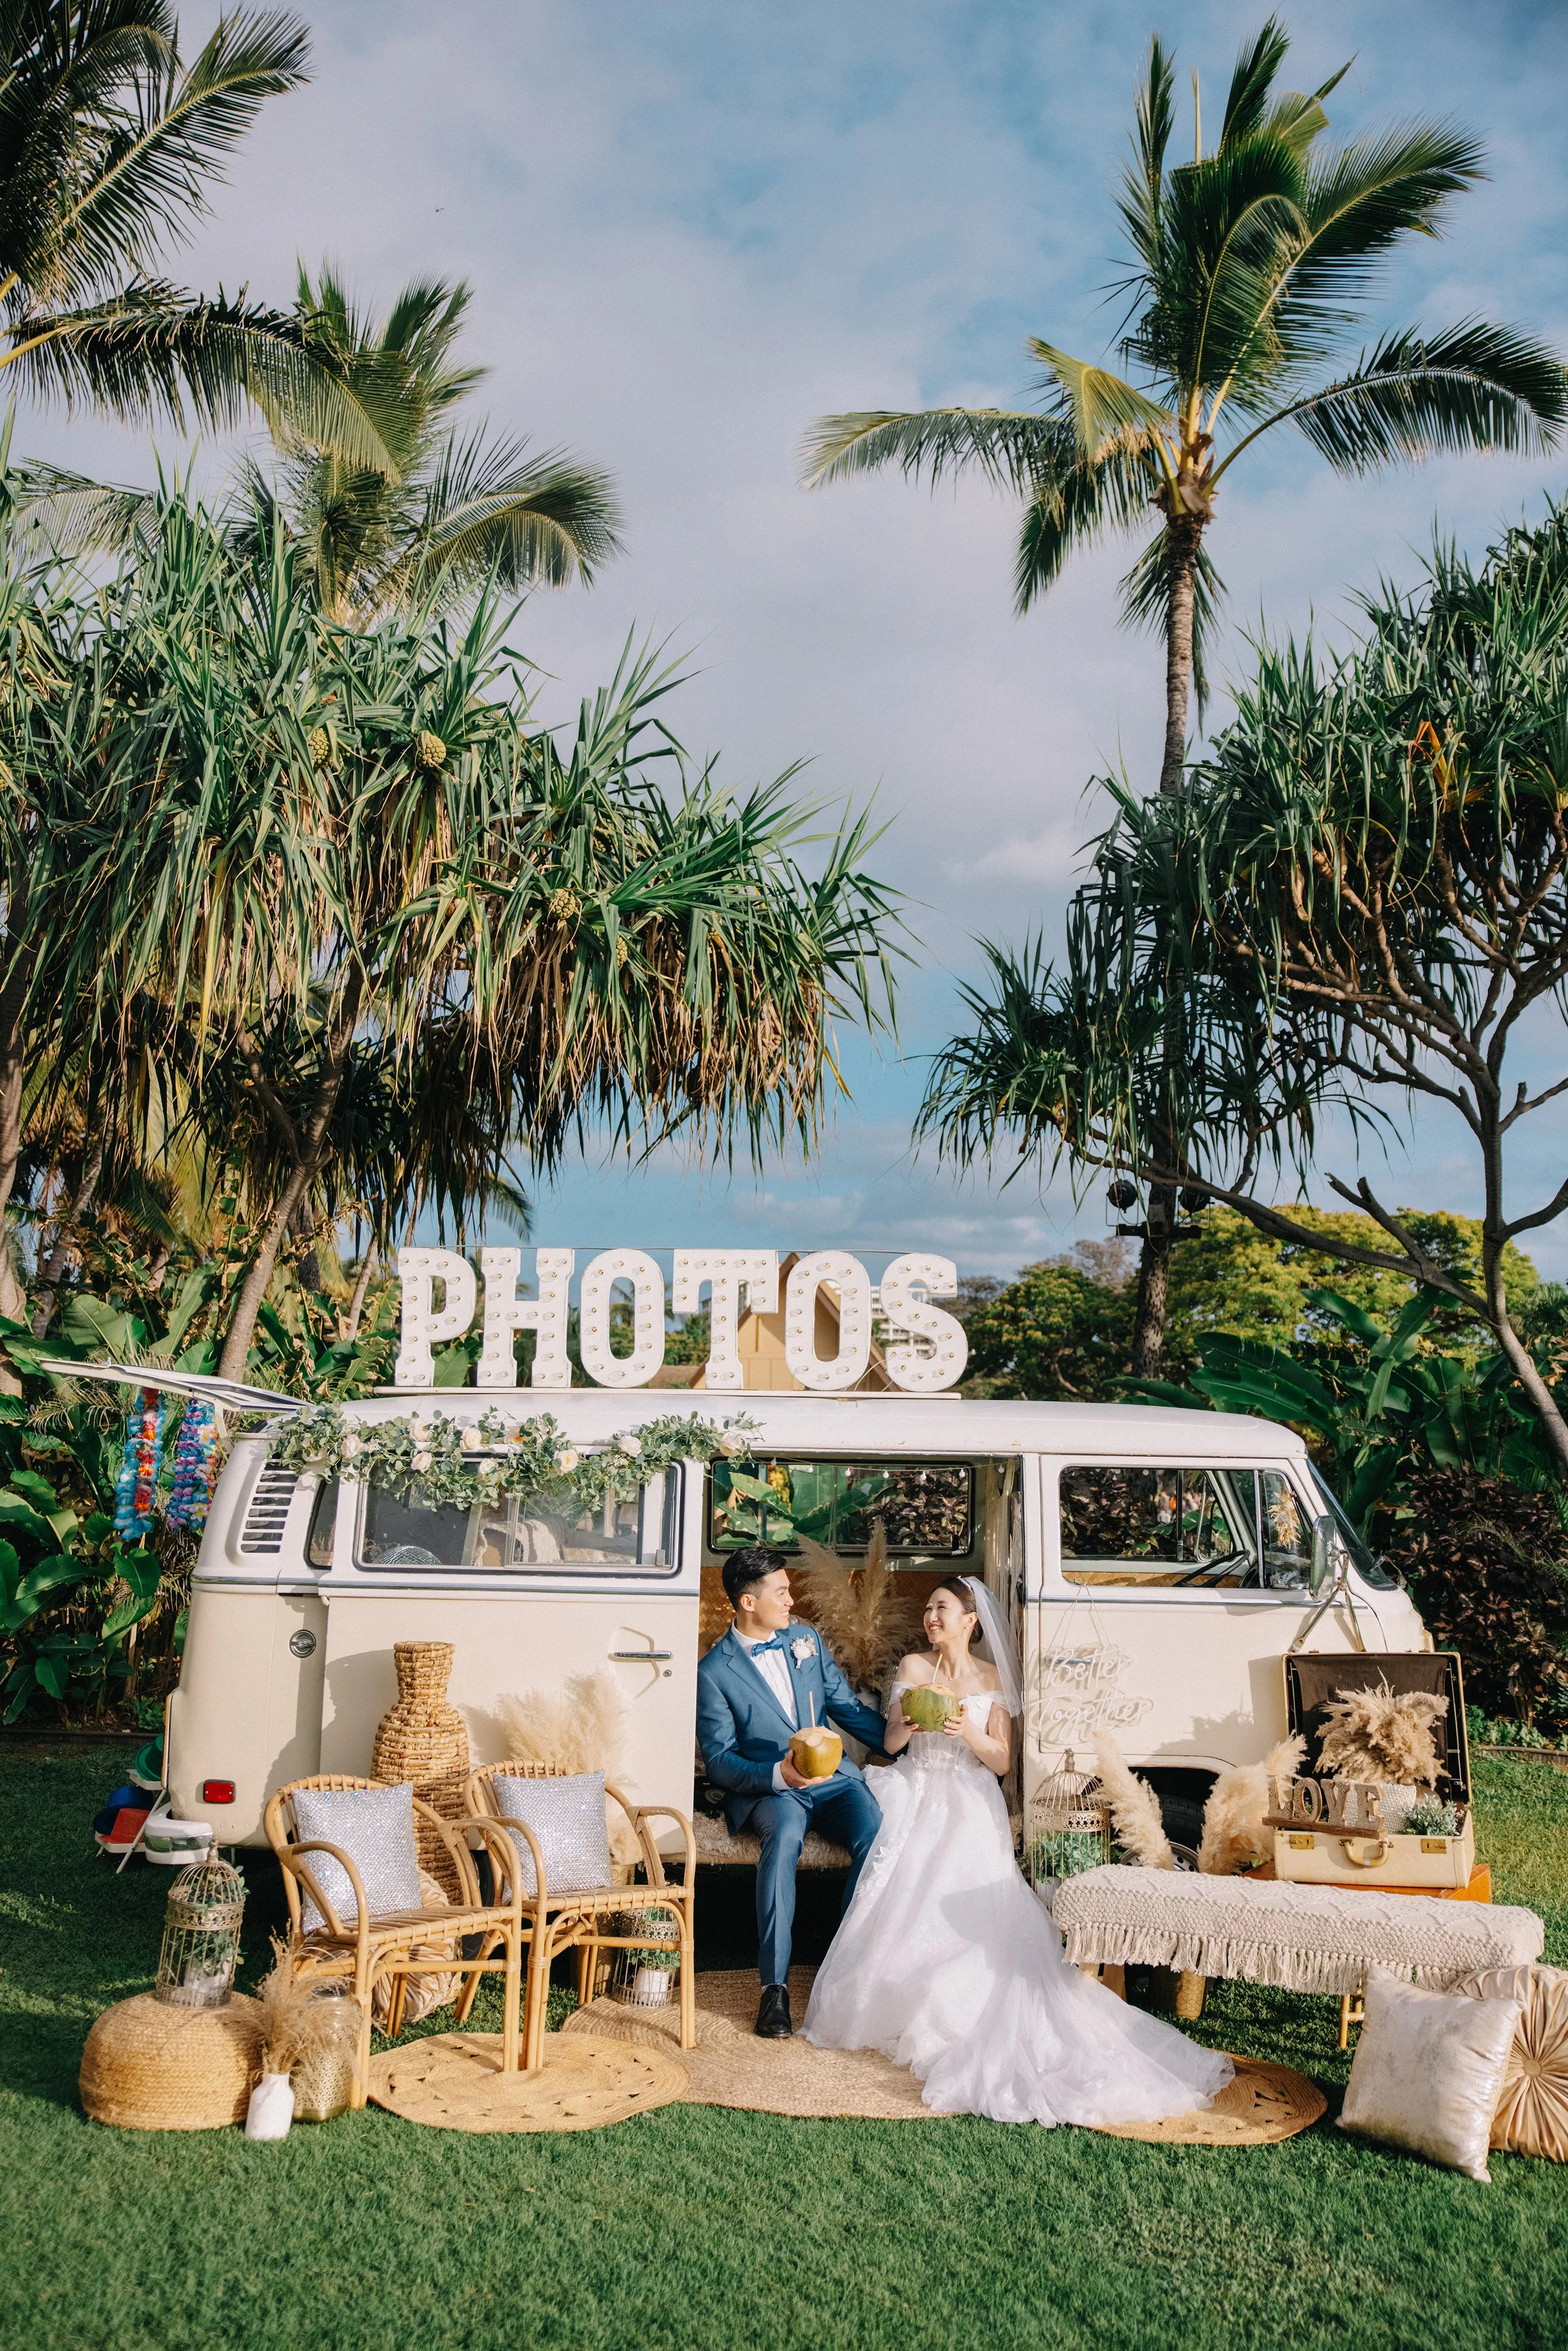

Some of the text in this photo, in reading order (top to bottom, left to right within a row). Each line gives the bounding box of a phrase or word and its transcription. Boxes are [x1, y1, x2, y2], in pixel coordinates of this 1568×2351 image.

[395, 1246, 968, 1392] PHOTOS
[1044, 1647, 1130, 1688] Better
[1029, 1687, 1150, 1741] Together
[1266, 1775, 1385, 1832] LOVE
